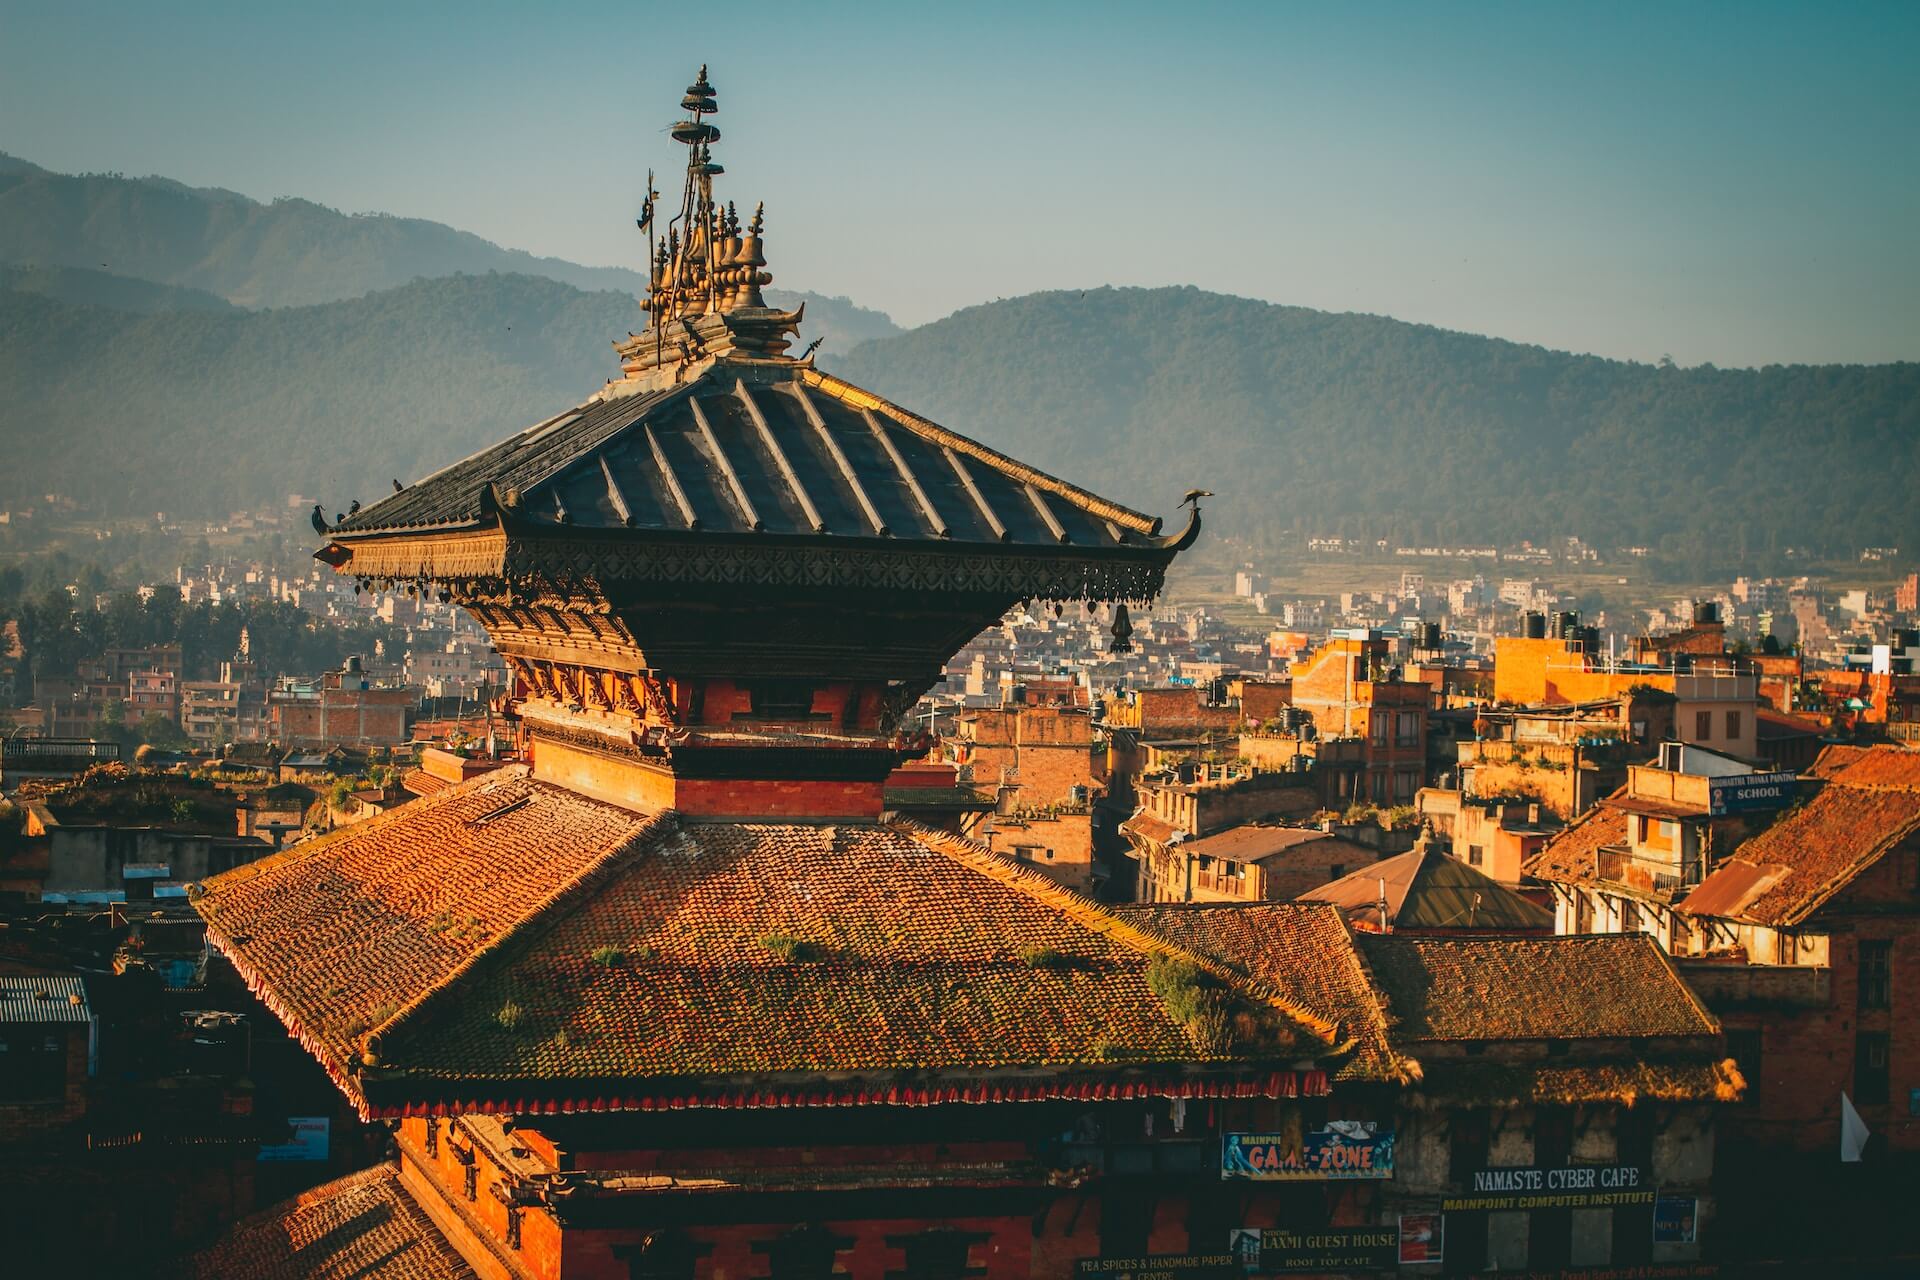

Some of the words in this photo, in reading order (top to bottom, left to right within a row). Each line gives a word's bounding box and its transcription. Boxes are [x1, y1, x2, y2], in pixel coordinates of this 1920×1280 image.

[1737, 787, 1783, 800] SCHOOL
[1474, 1170, 1543, 1192] NAMASTE
[1547, 1168, 1596, 1189] CYBER
[1601, 1167, 1639, 1188] CAFE
[1443, 1197, 1516, 1211] MAINPOINT
[1519, 1195, 1587, 1208] COMPUTER
[1590, 1192, 1655, 1205] INSTITUTE
[1263, 1235, 1302, 1249] LAXMI
[1306, 1234, 1350, 1248] GUEST
[1352, 1233, 1396, 1247] HOUSE
[1140, 1259, 1147, 1269] &
[1150, 1256, 1200, 1269] HANDMADE
[1202, 1255, 1233, 1266] PAPER
[1320, 1257, 1339, 1266] TOP
[1137, 1272, 1174, 1280] CENTRE
